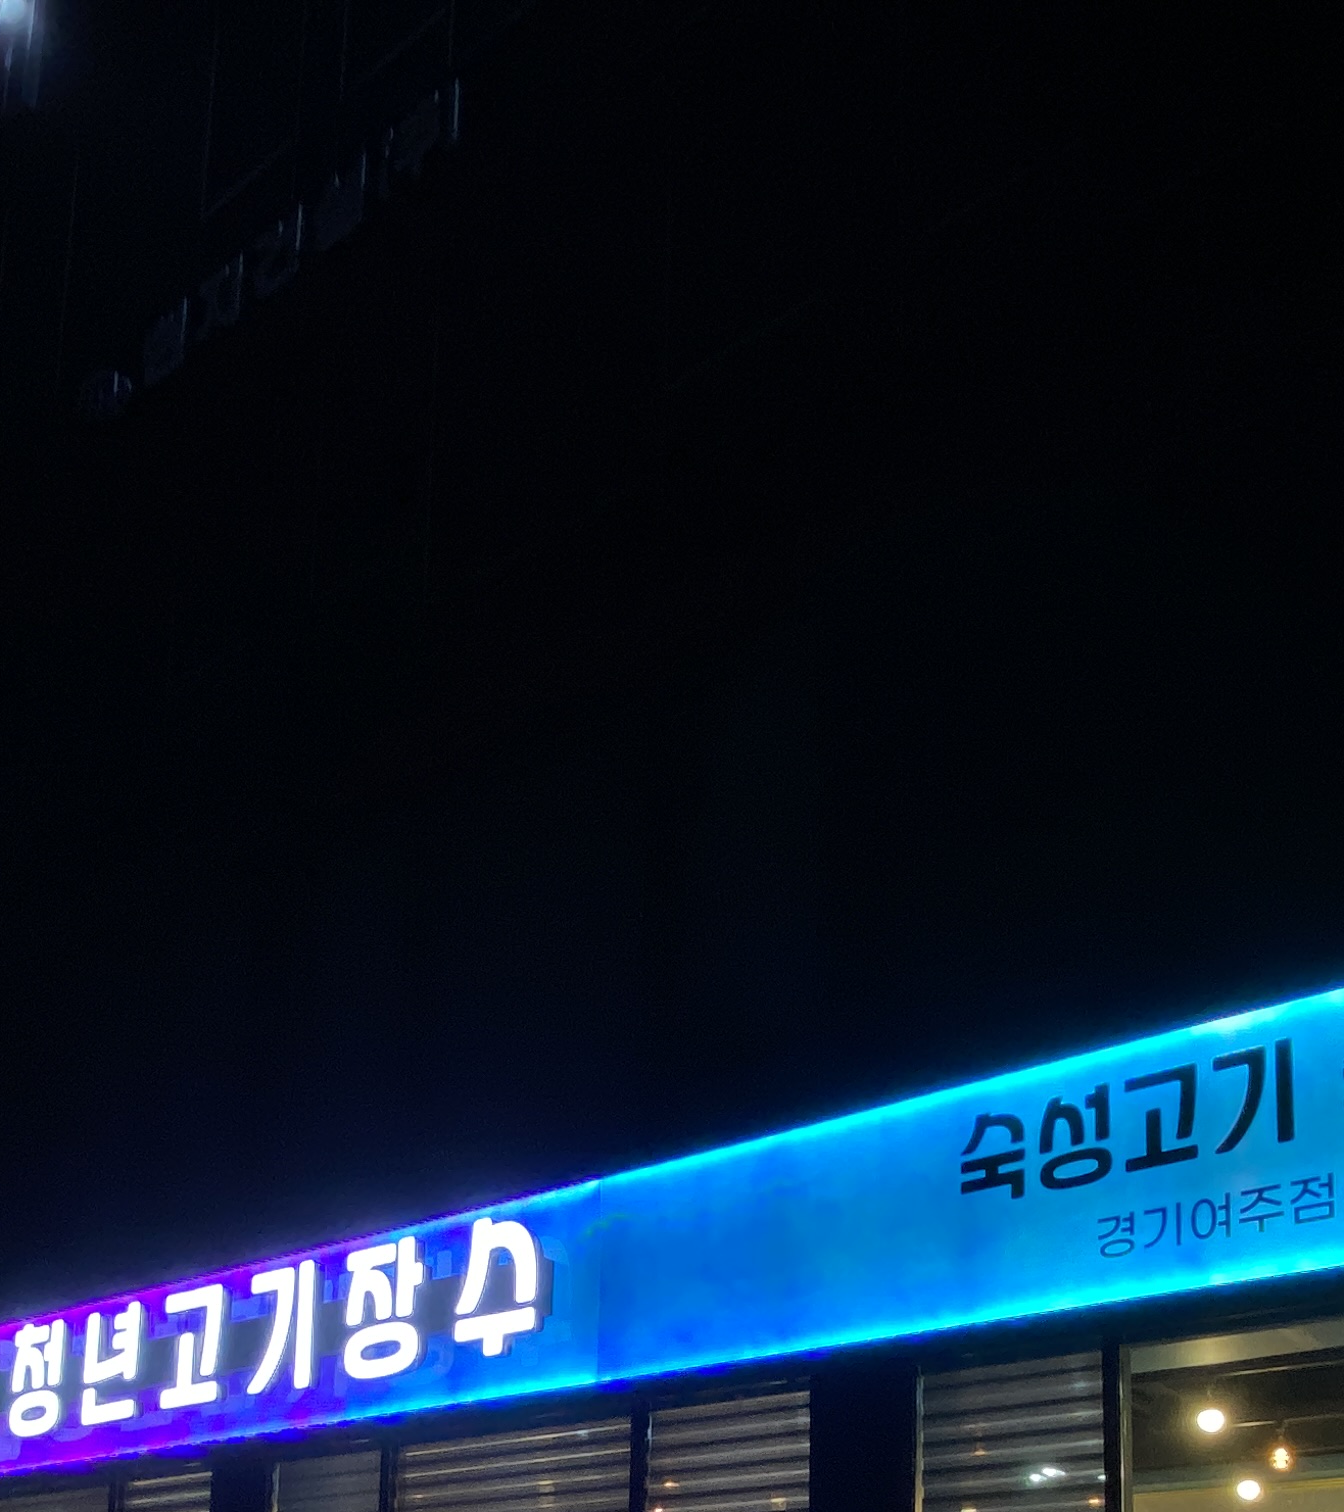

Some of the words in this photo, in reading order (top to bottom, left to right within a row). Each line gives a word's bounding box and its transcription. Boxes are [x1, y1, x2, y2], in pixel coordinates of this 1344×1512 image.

[960, 1038, 1296, 1199] 숙성고기
[1096, 1173, 1337, 1258] 경기여주점
[6, 1216, 544, 1440] 청년고기장수
